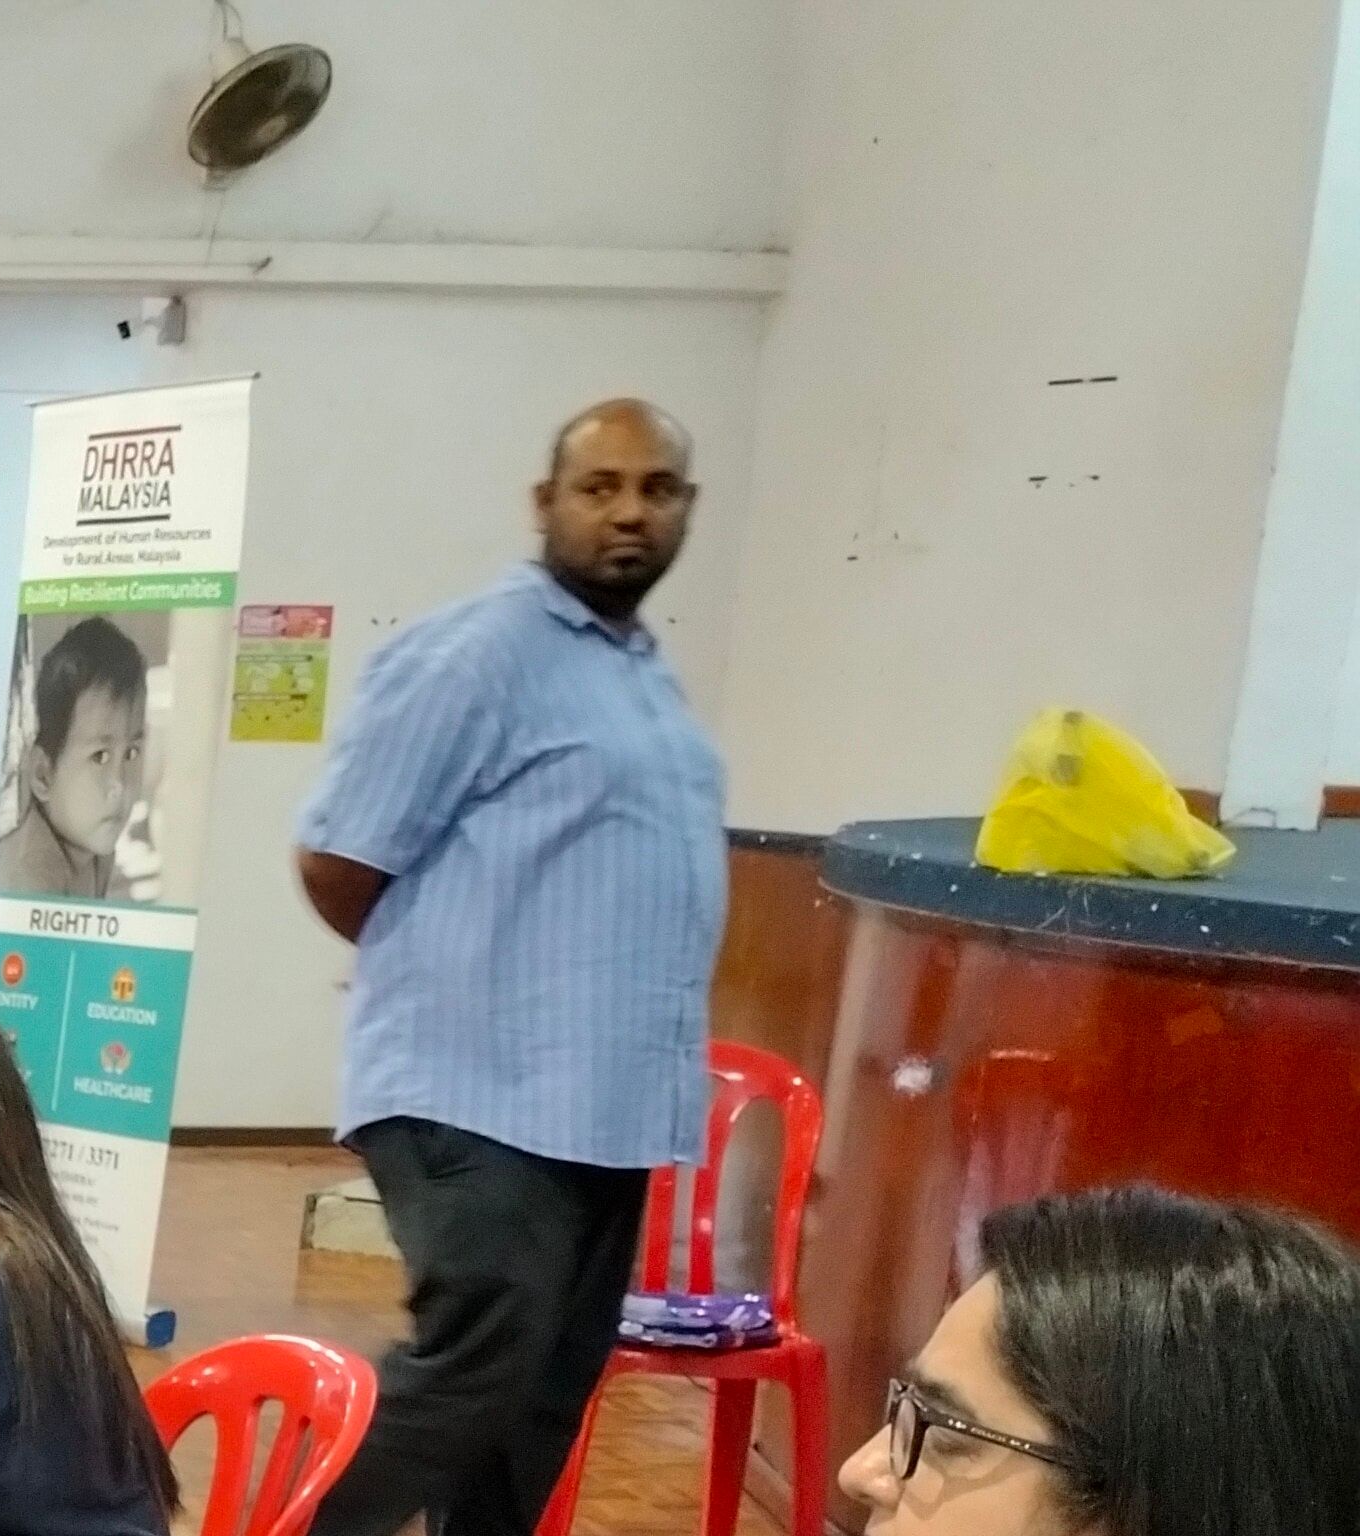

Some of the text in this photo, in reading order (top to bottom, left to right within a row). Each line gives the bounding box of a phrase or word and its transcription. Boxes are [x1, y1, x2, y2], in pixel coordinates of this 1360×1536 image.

[82, 439, 175, 482] DHRRA
[77, 481, 171, 512] MALAYSIA
[153, 527, 212, 541] Resources
[137, 549, 182, 565] Malaysia
[130, 578, 222, 600] Communities
[29, 908, 120, 937] RIGHT TO
[86, 1002, 158, 1026] EDUCATION
[73, 1077, 153, 1104] HEALTHCARE
